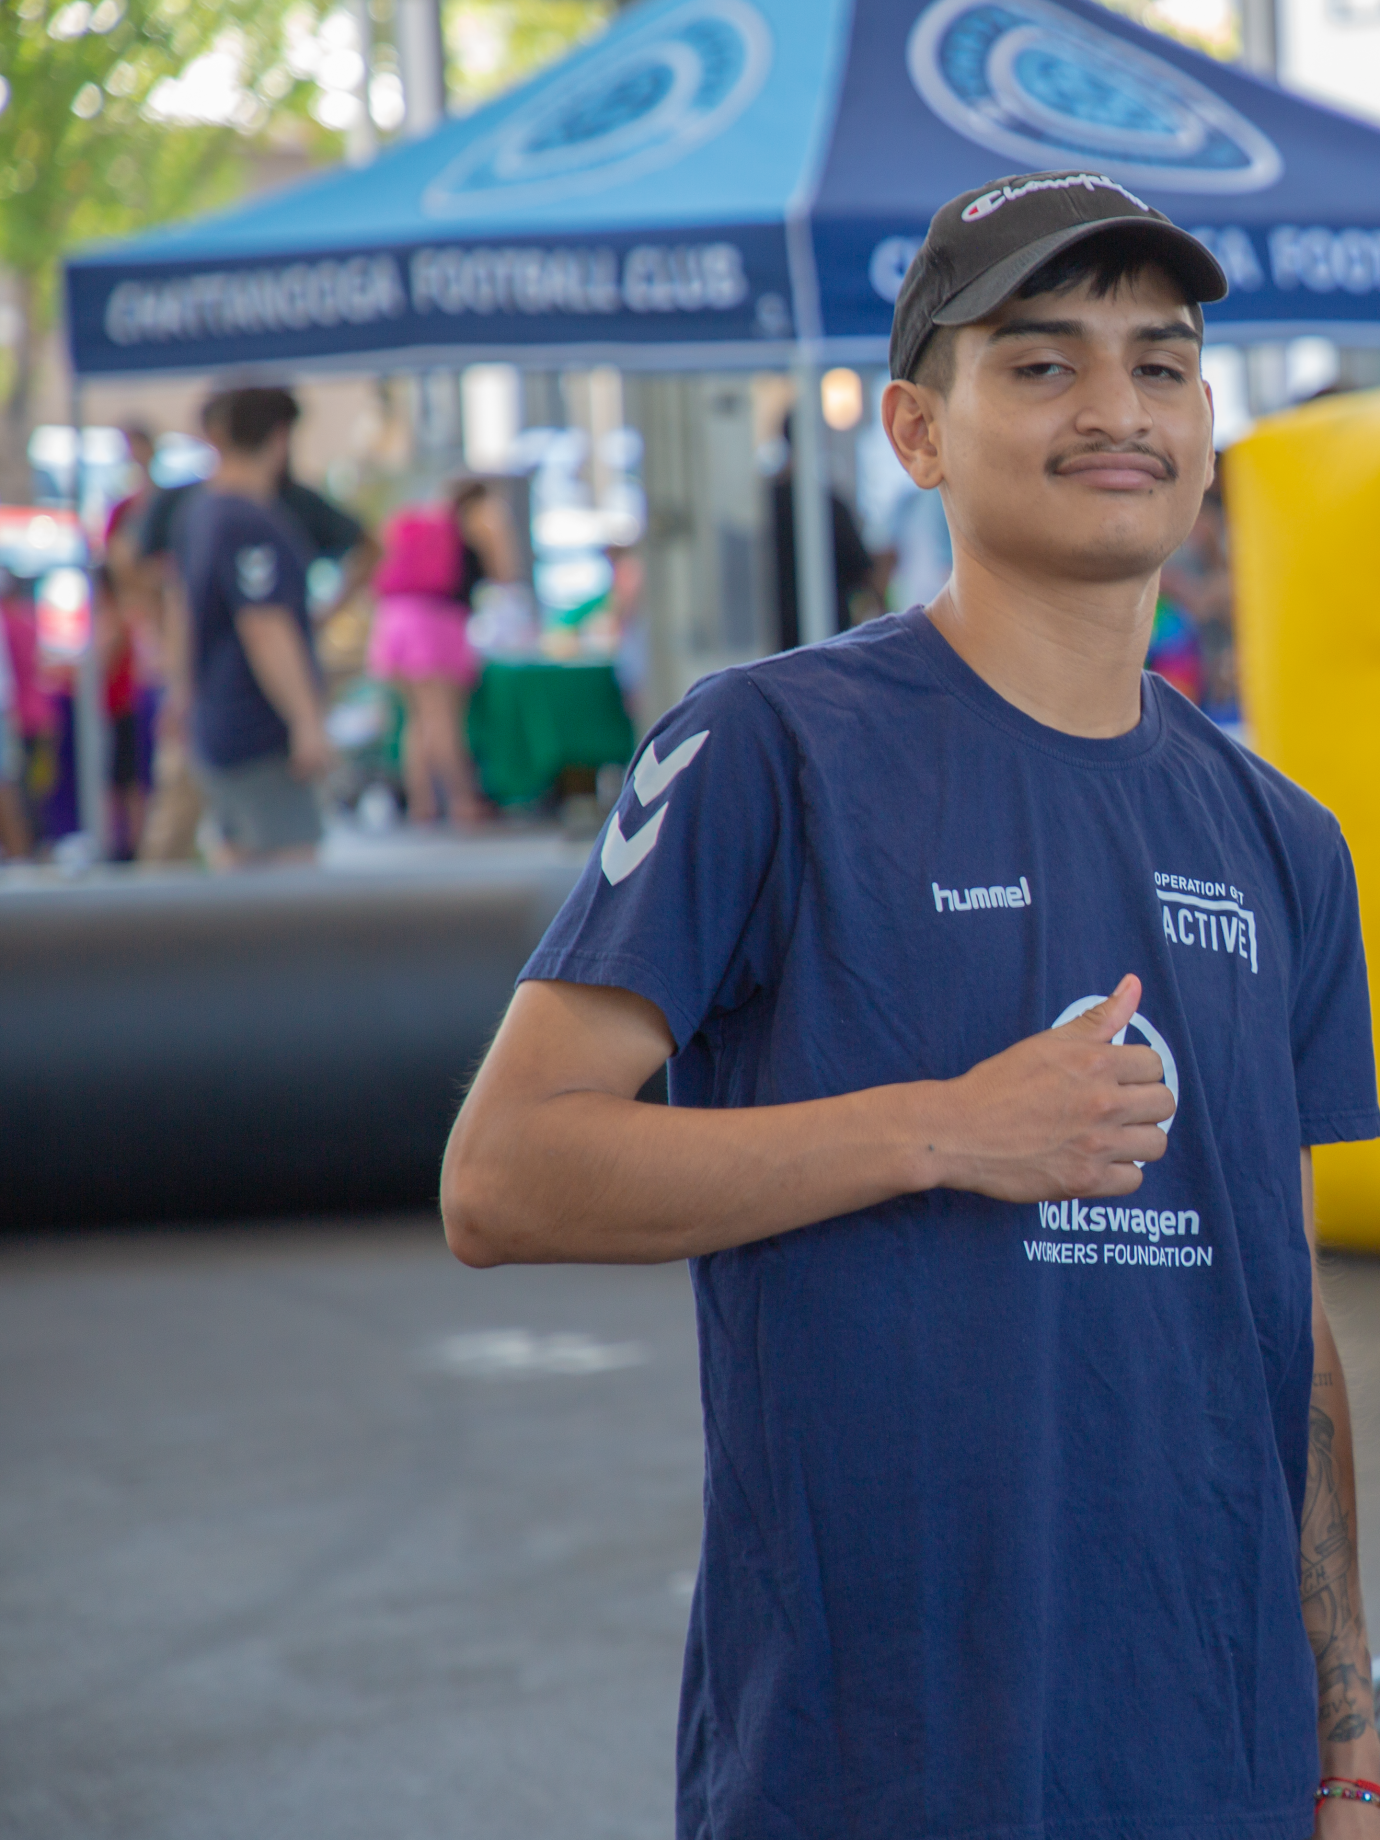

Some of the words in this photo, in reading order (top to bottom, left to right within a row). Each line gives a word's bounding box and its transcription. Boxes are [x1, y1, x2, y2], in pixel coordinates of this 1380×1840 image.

[411, 248, 620, 314] FOOTBALL
[625, 244, 747, 311] CLUB
[931, 876, 1032, 913] hummel
[1154, 871, 1226, 897] OPERATION
[1229, 885, 1244, 906] GT
[1162, 905, 1248, 959] ACTIVE
[1038, 1198, 1201, 1243] Volkswagen
[1103, 1243, 1213, 1268] FOUNDATION
